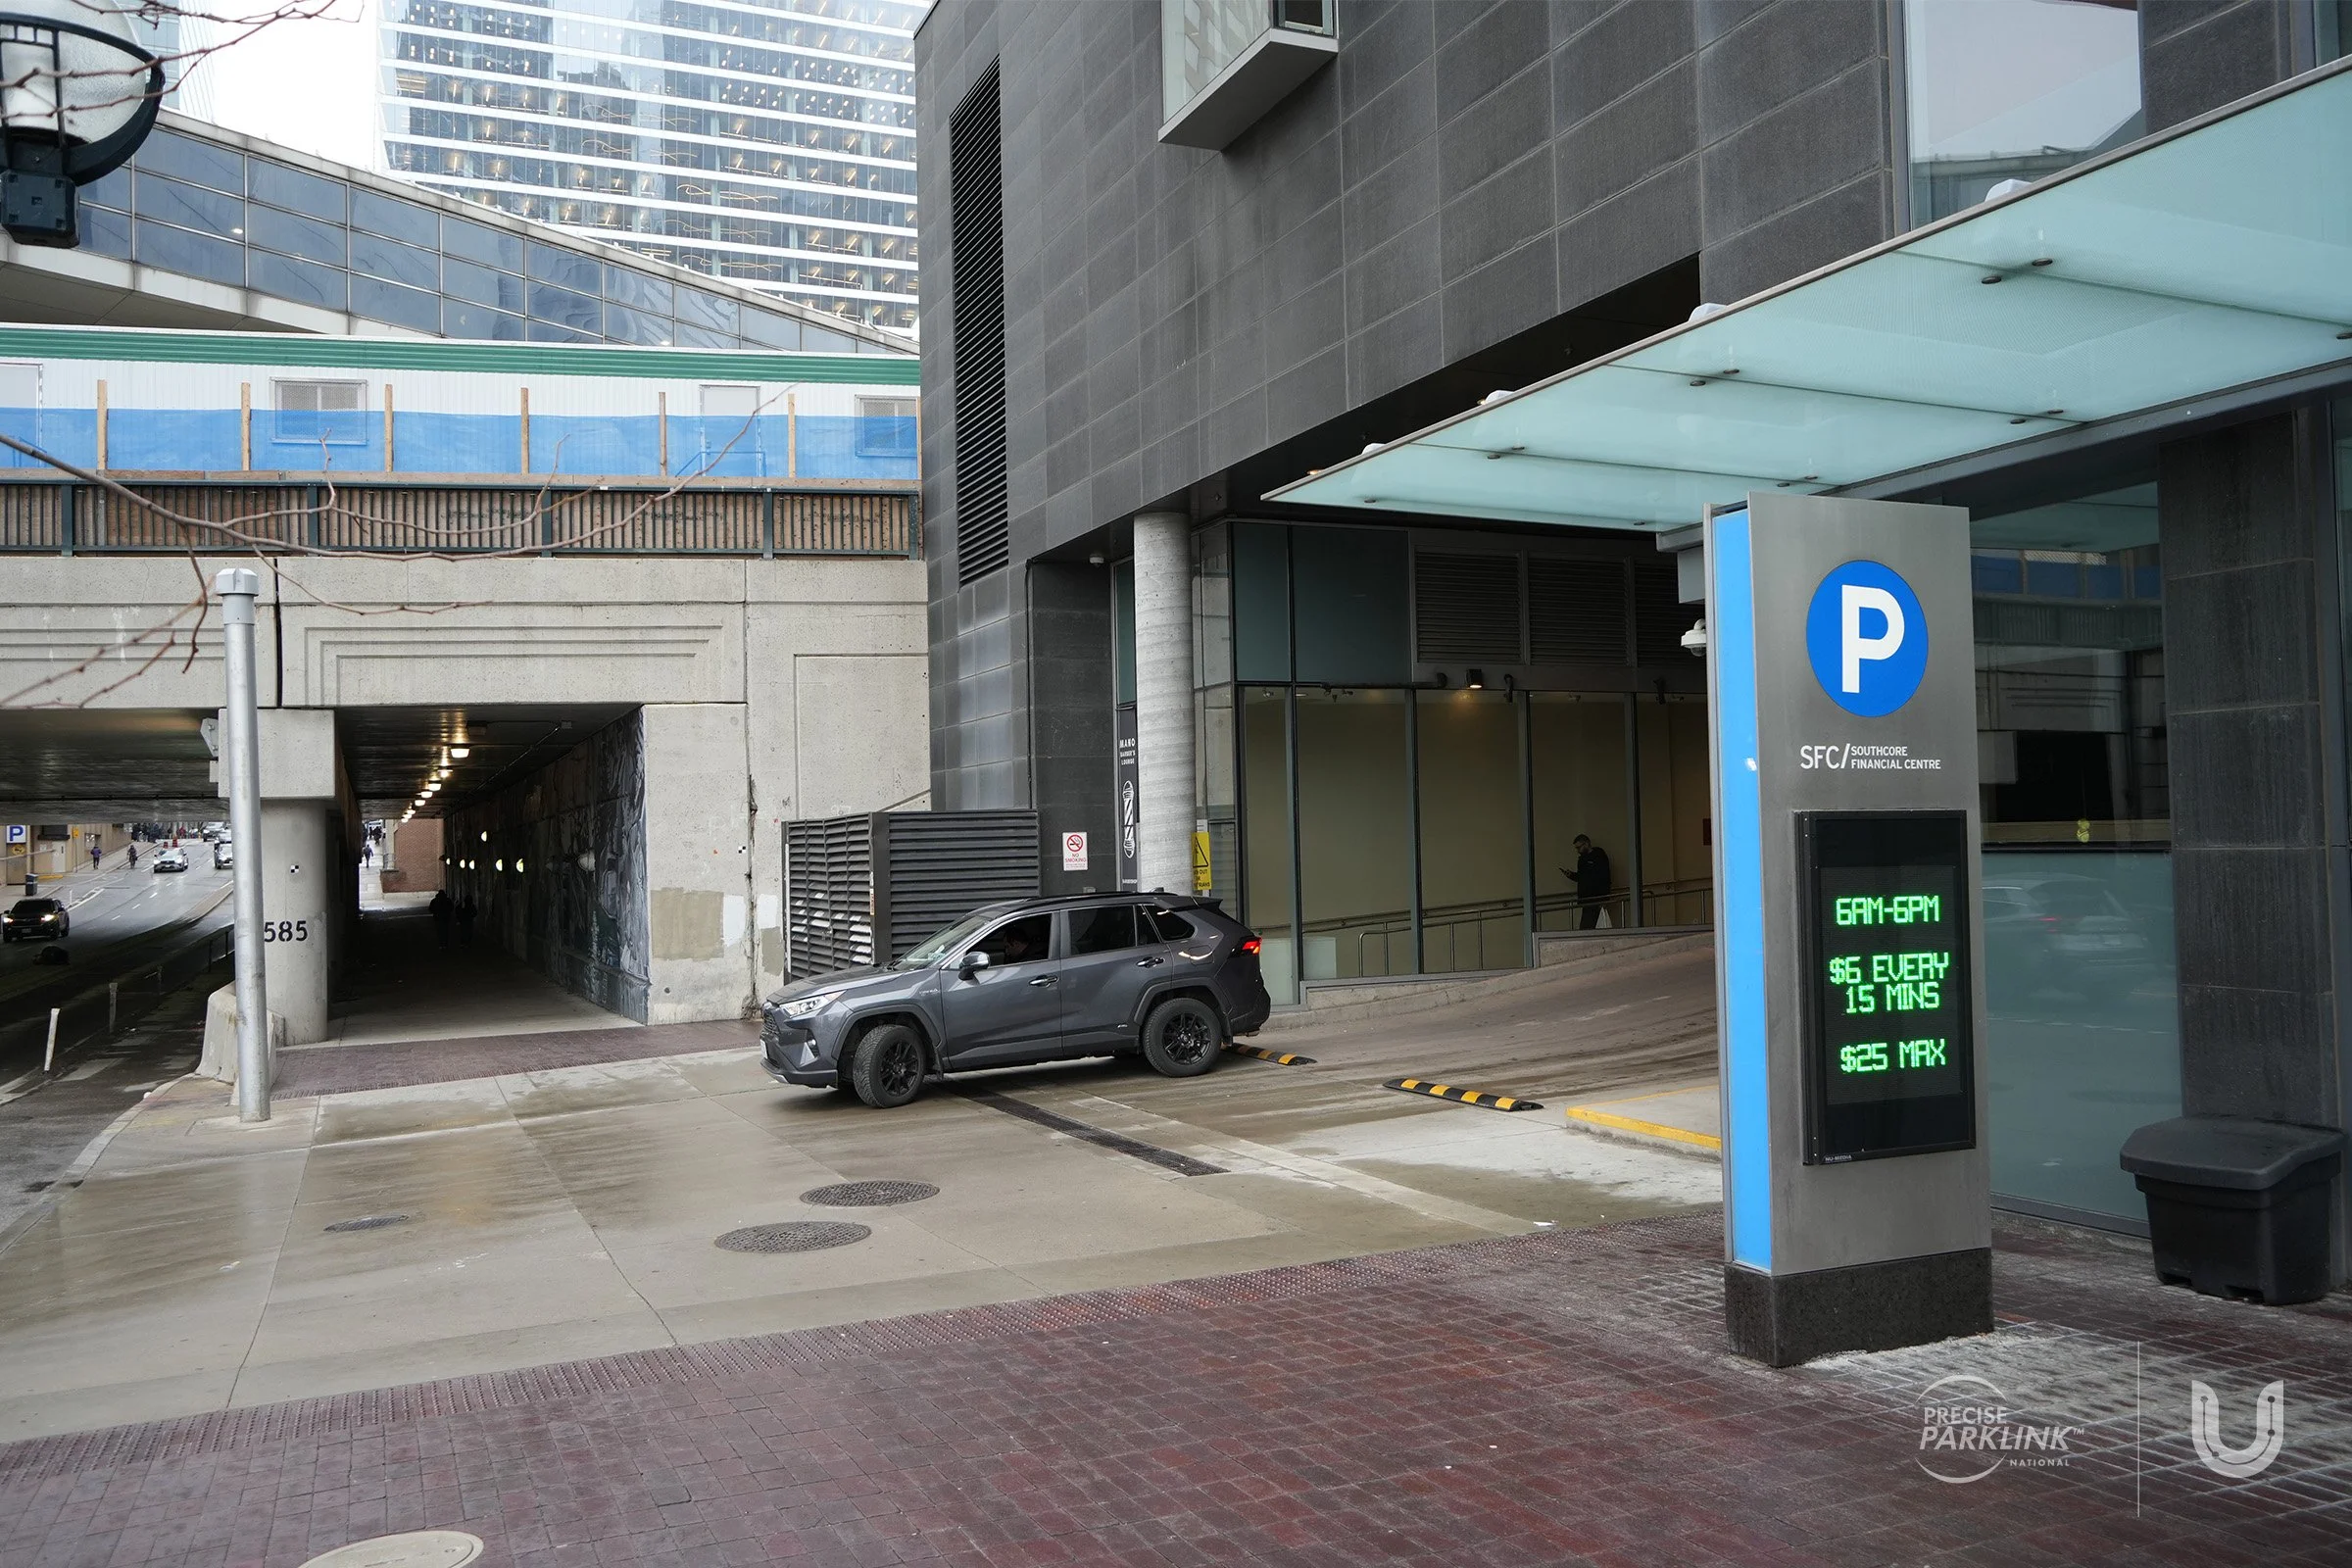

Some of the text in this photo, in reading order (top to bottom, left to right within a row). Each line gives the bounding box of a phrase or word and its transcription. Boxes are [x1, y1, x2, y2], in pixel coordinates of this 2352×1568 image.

[1841, 584, 1904, 694] P
[1850, 746, 1908, 757] SOUTHCORE
[1850, 759, 1941, 769] FINANCIAL CENTRE
[9, 825, 24, 842] P
[1836, 895, 1939, 925] 6AM-6PM
[264, 920, 308, 943] 585
[1829, 952, 1949, 985] $6 EVERY
[1845, 981, 1940, 1014] 15 MINS
[1839, 1038, 1946, 1073] $25 MAX
